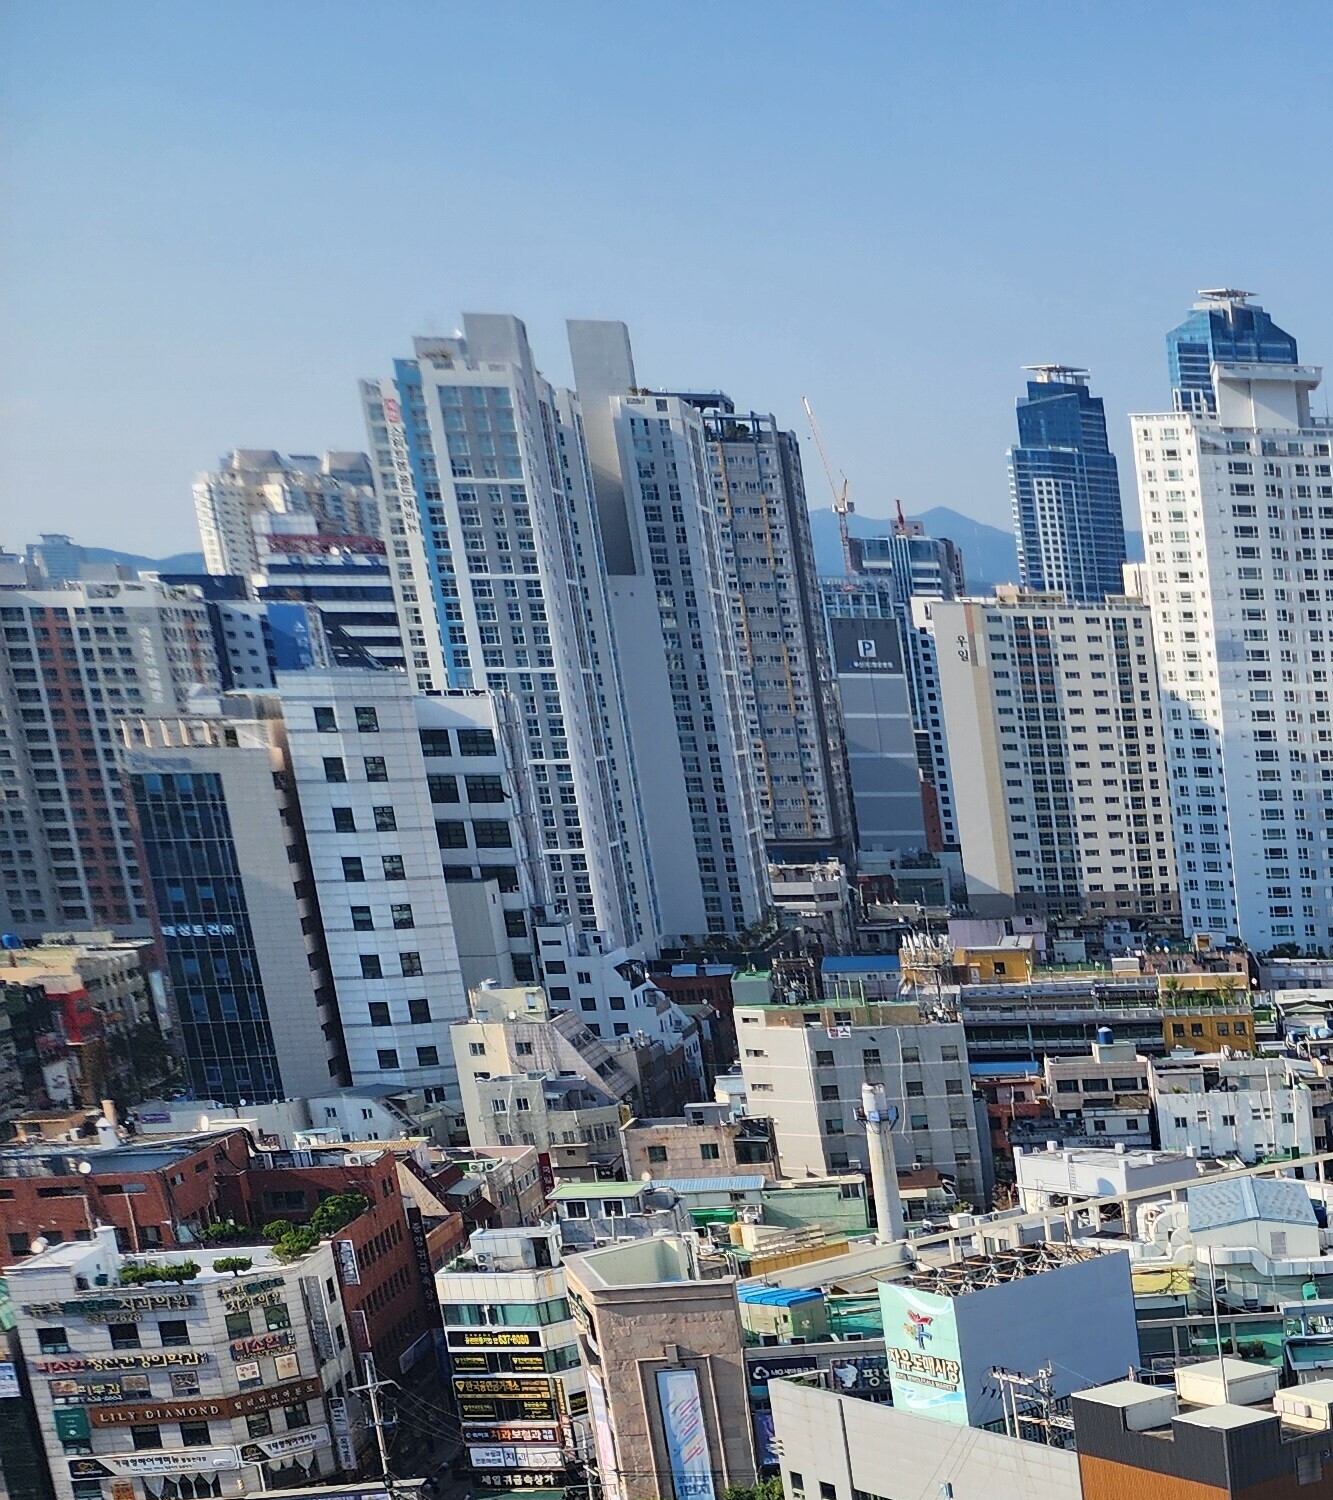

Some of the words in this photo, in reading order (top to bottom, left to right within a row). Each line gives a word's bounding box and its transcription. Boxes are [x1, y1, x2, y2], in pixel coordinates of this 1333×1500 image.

[862, 641, 873, 657] P
[956, 635, 969, 662] 우일
[234, 1334, 280, 1353] 미소인
[888, 1347, 961, 1385] 자유도매시장
[99, 1410, 136, 1424] LILY
[145, 1404, 220, 1421] DIAMOND
